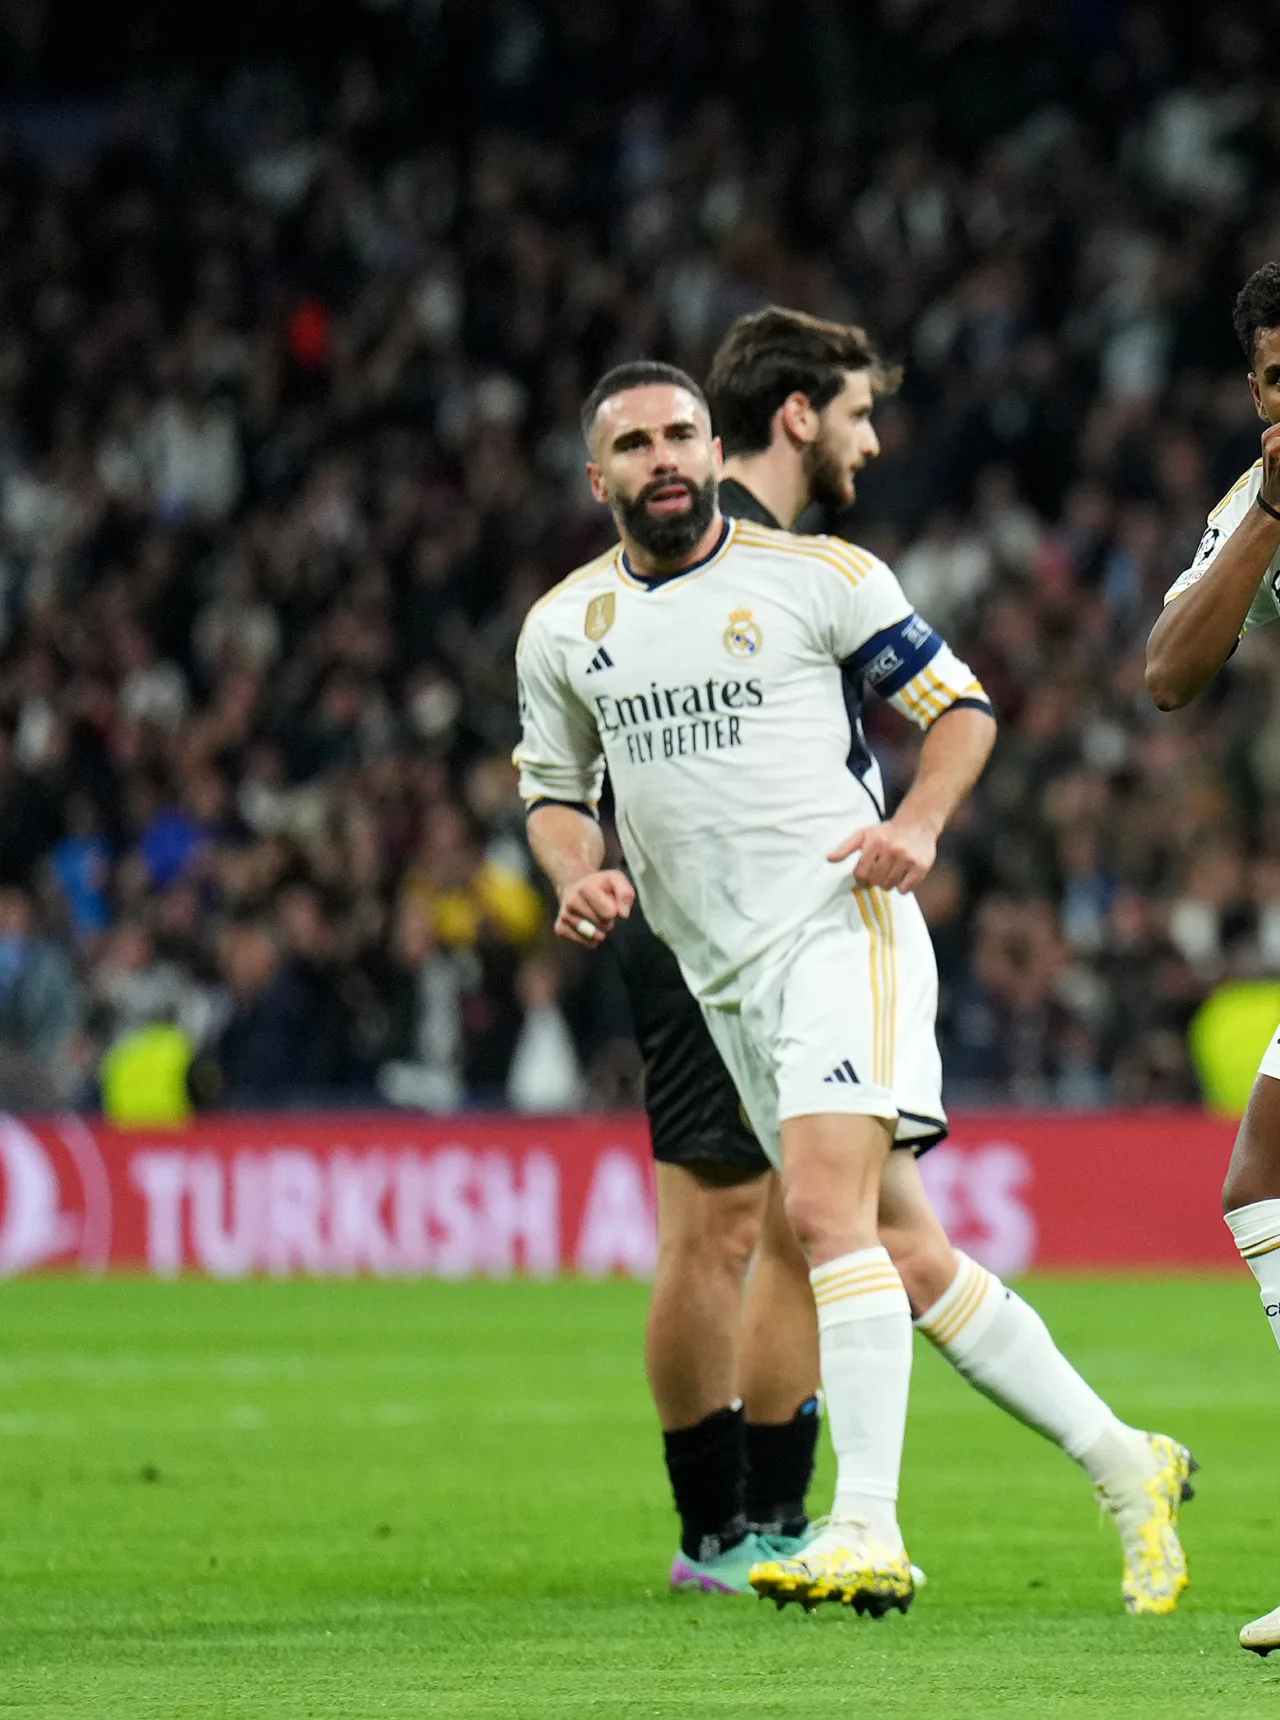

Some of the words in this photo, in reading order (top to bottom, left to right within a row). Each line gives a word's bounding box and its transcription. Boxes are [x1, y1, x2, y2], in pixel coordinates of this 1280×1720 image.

[594, 676, 764, 732] Emirates
[626, 731, 654, 765] FLY
[662, 715, 742, 758] BETTER
[131, 1146, 561, 1278] TURKISH
